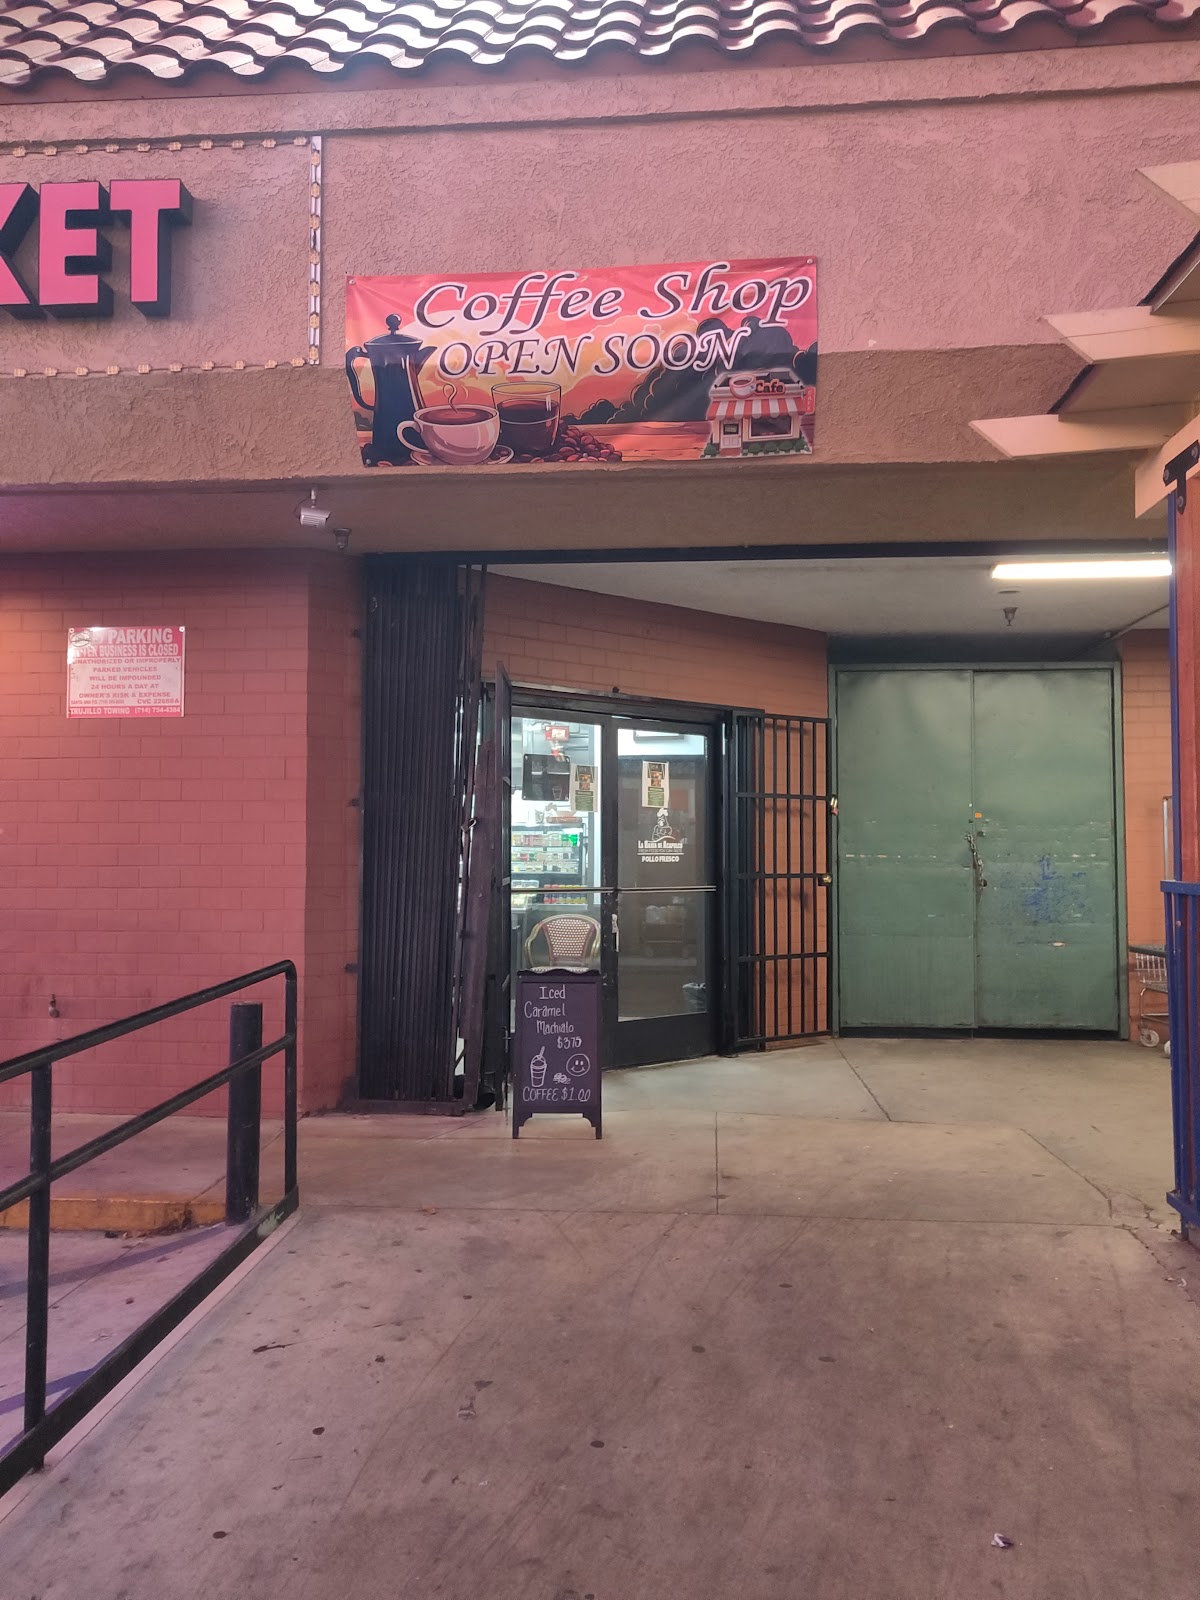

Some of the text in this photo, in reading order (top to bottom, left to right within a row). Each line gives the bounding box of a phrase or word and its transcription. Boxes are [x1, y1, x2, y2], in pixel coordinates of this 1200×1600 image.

[414, 261, 813, 336] Coffee Shop
[438, 328, 751, 377] OPEN SOON
[754, 382, 784, 393] Cafe
[109, 628, 173, 644] PARKING
[99, 644, 138, 657] BUSINESS
[139, 644, 147, 656] IS
[148, 643, 179, 656] CLOSED
[539, 984, 566, 1000] Iced
[524, 1001, 566, 1018] Caramel
[522, 1086, 590, 1102] COFFEE $1.00
